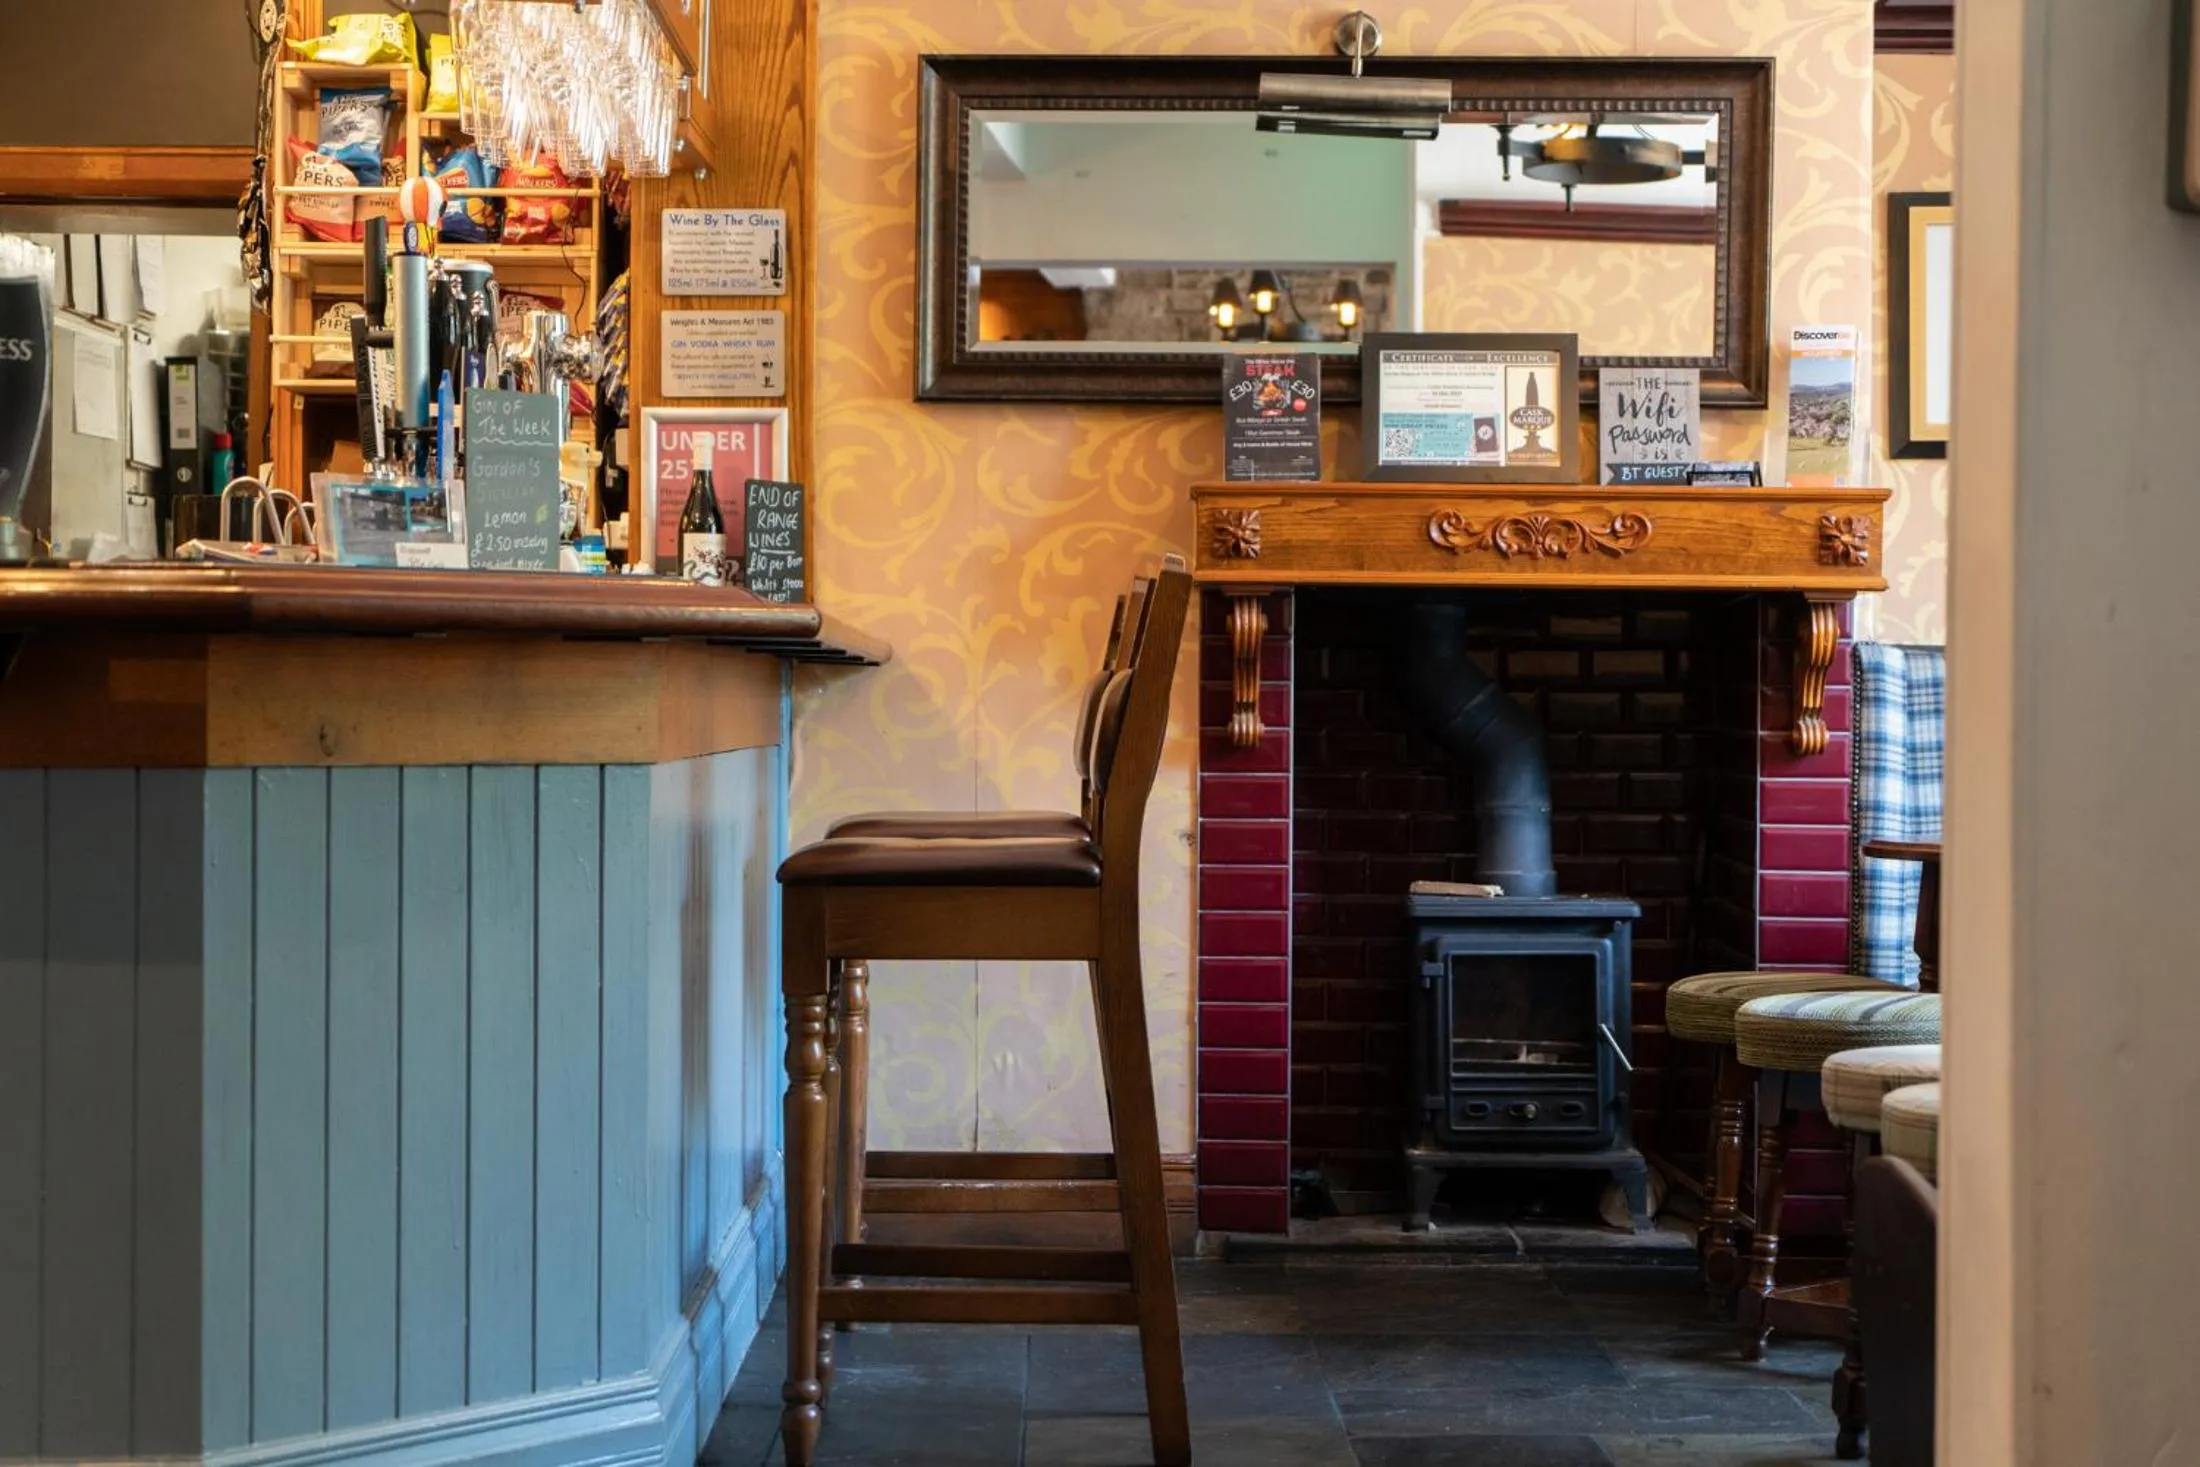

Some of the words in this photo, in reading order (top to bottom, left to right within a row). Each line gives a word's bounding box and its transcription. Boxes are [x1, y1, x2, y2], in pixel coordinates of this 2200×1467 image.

[304, 170, 345, 187] PERS
[669, 213, 700, 226] Wine
[704, 213, 719, 228] By
[724, 213, 743, 226] The
[748, 213, 780, 227] Glass
[319, 318, 351, 332] PIPE
[1793, 330, 1839, 341] Discover
[1391, 352, 1455, 363] CERTIFICATE
[1486, 352, 1549, 363] EXCELLENCE
[1245, 364, 1295, 376] STEAK
[1229, 380, 1253, 402] £30
[1291, 380, 1316, 400] £30
[1636, 377, 1661, 390] THE
[1617, 391, 1683, 427] Wifi
[477, 416, 506, 436] The
[1608, 423, 1692, 455] Password
[1654, 447, 1669, 461] is
[472, 455, 541, 478] Gordon's
[660, 459, 690, 480] 25
[1621, 467, 1642, 481] BT
[1644, 465, 1684, 480] GUEST
[750, 484, 780, 508] END
[784, 490, 801, 507] OF
[484, 511, 528, 529] Lemon
[757, 509, 799, 530] RANGE
[748, 530, 791, 548] WINES
[769, 558, 785, 577] per
